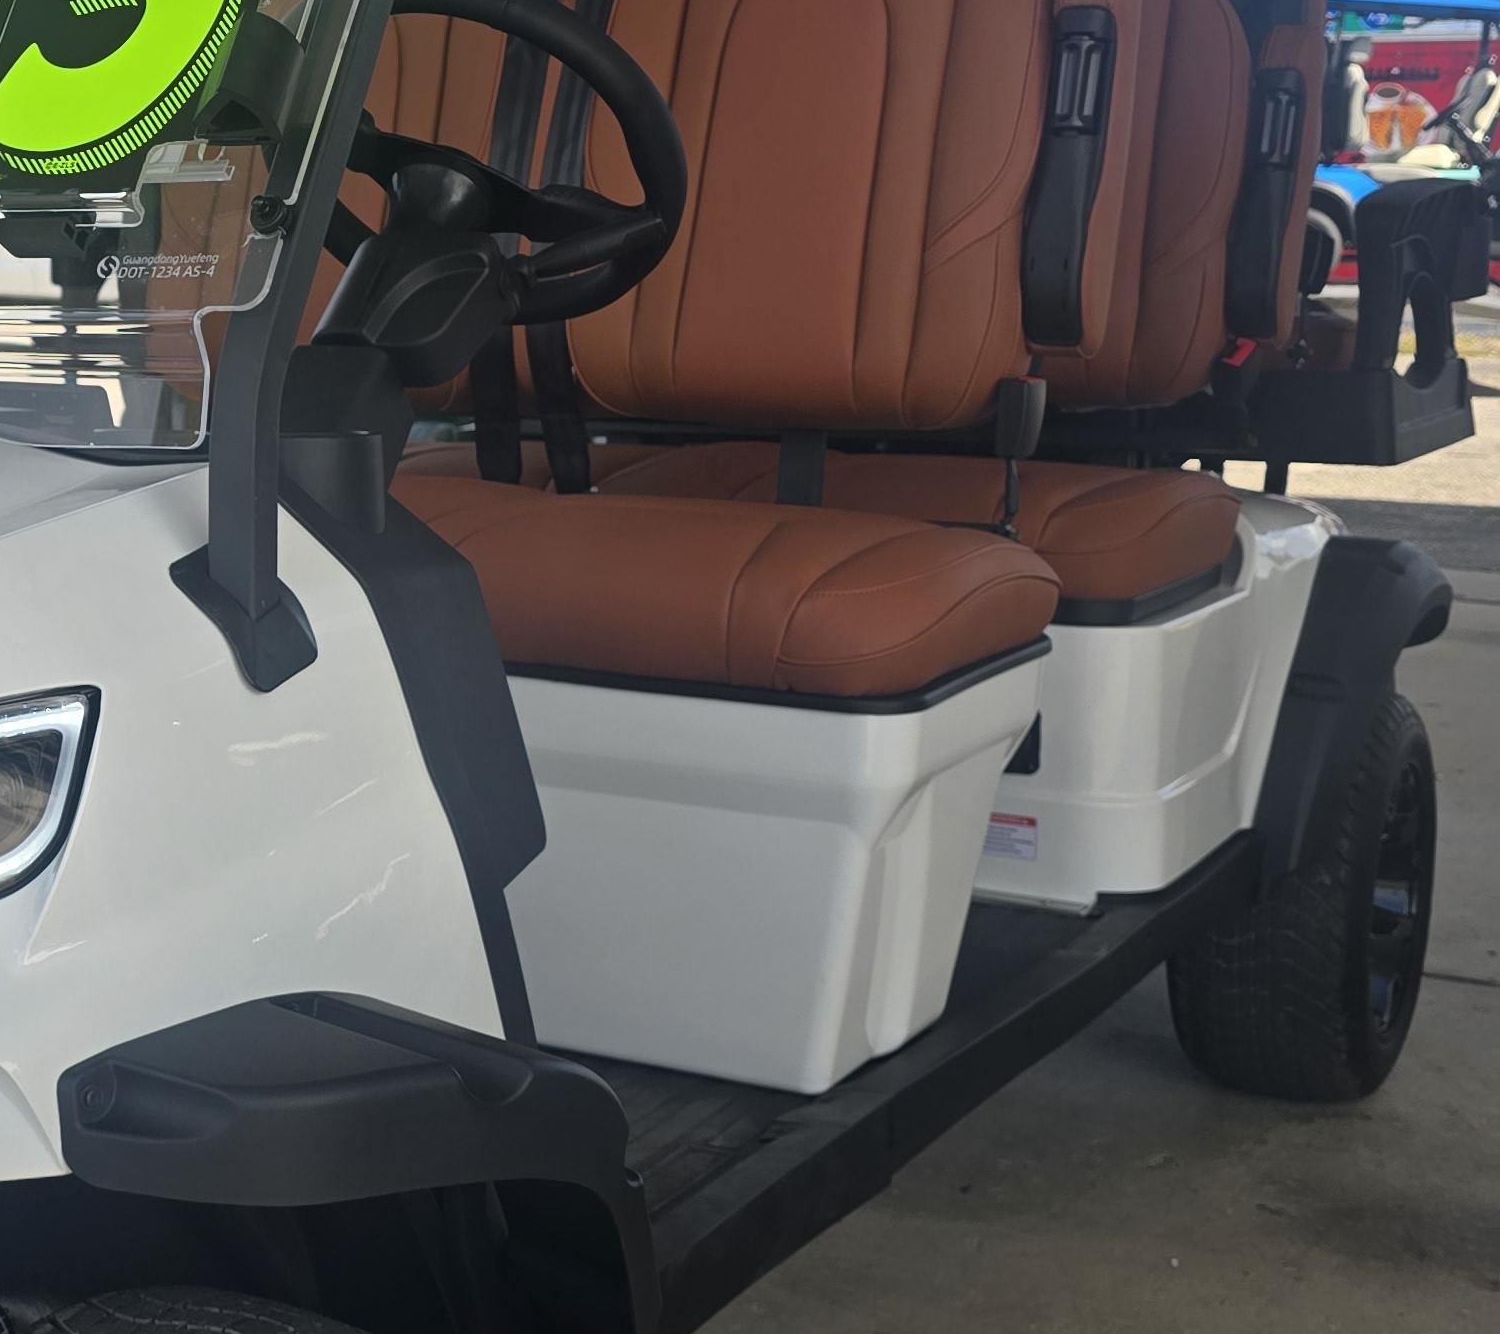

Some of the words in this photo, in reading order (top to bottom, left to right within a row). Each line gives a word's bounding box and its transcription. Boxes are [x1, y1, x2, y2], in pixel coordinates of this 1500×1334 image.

[122, 253, 220, 266] GuangdongYuefeng
[118, 266, 180, 279] DOT-1234
[182, 265, 216, 278] AS-4
